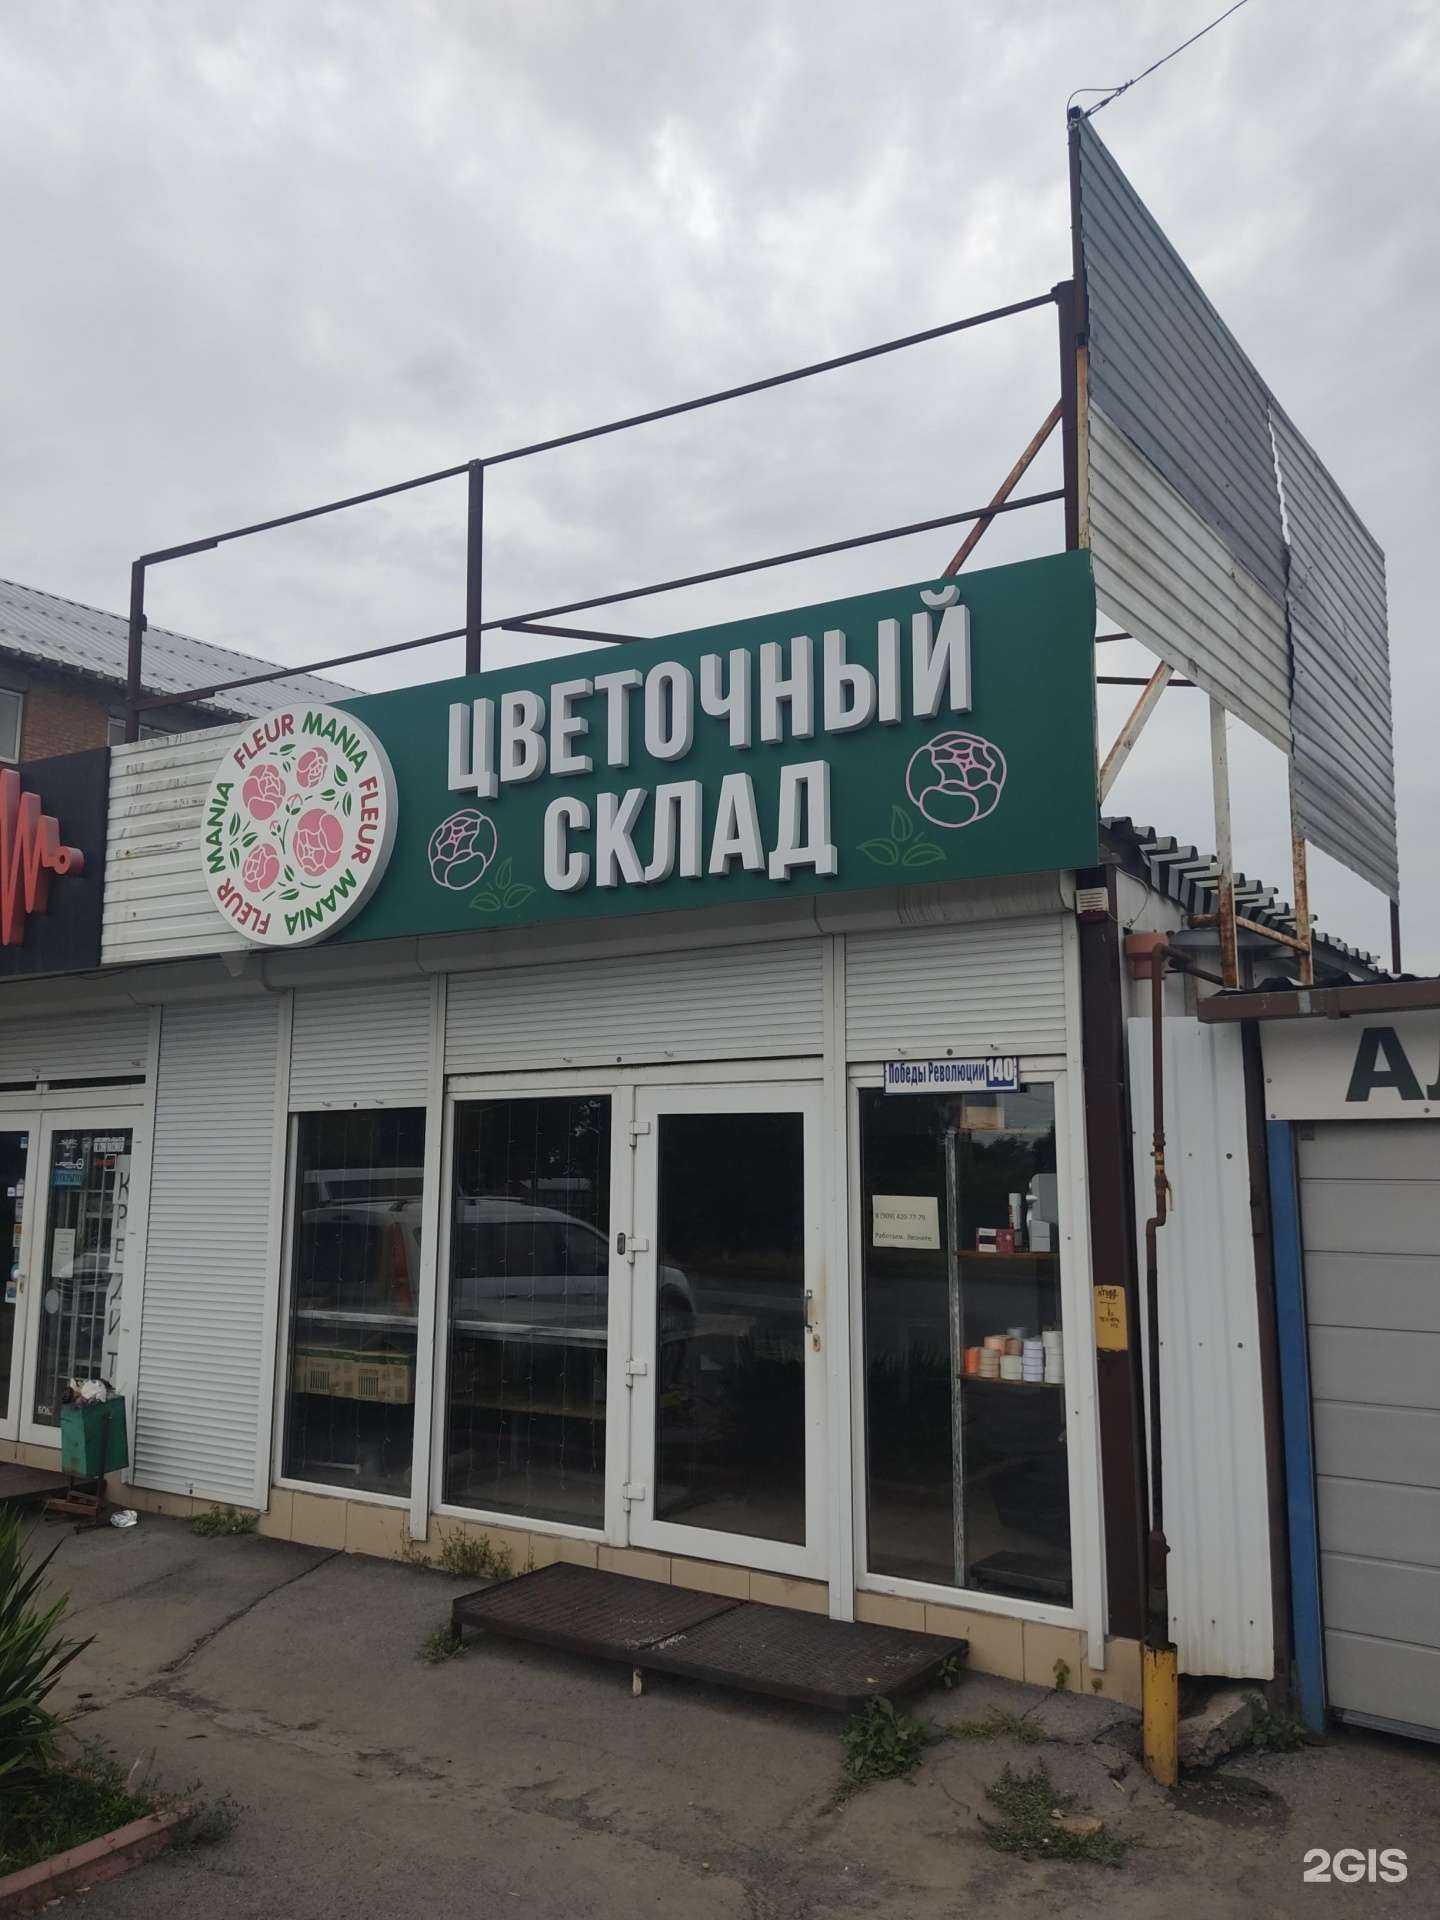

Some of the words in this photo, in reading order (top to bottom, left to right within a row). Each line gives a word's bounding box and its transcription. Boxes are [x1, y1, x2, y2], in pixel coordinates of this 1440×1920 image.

[448, 585, 973, 799] ЦВЕТОЧНЫЙ
[233, 713, 295, 770] FLEUR
[302, 711, 369, 774] MANIA
[206, 782, 234, 874] MANIA
[351, 776, 379, 864] FLEUR
[543, 759, 838, 892] СКЛАД
[216, 878, 271, 935] FLEUR
[284, 868, 357, 936] MANIA
[888, 1062, 926, 1086] Победы
[928, 1062, 985, 1084] Революции
[987, 1057, 1014, 1081] 140
